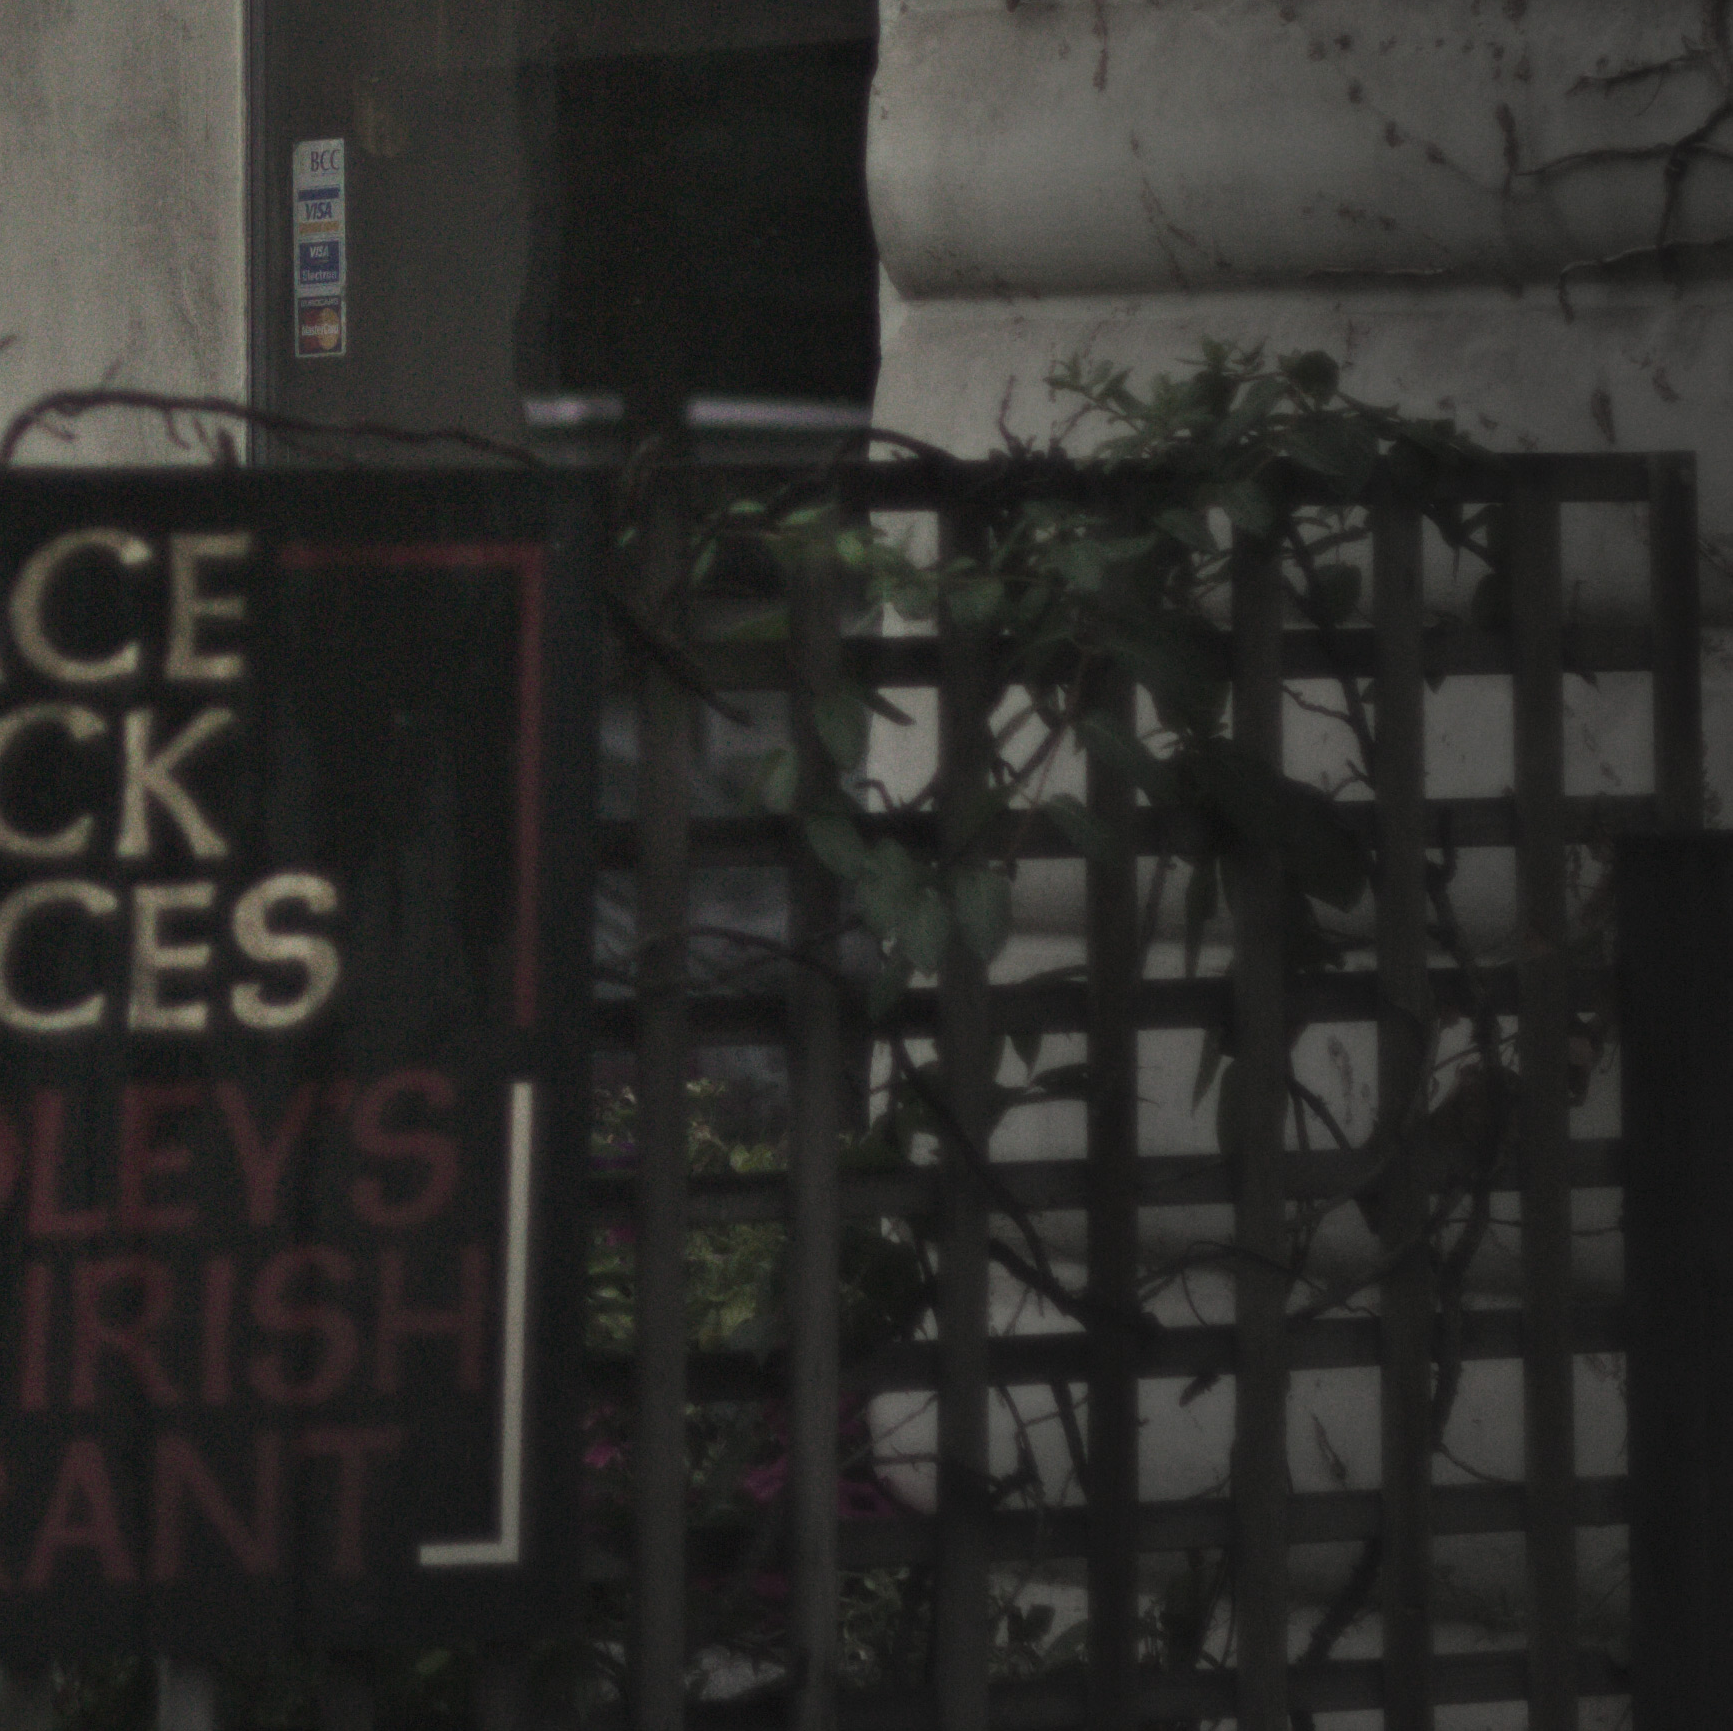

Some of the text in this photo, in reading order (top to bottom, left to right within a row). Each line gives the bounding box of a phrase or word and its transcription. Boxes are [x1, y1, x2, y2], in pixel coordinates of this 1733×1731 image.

[310, 149, 340, 171] BCC
[305, 202, 333, 220] VISA
[309, 244, 330, 259] VISA
[17, 1242, 492, 1415] IRISH
